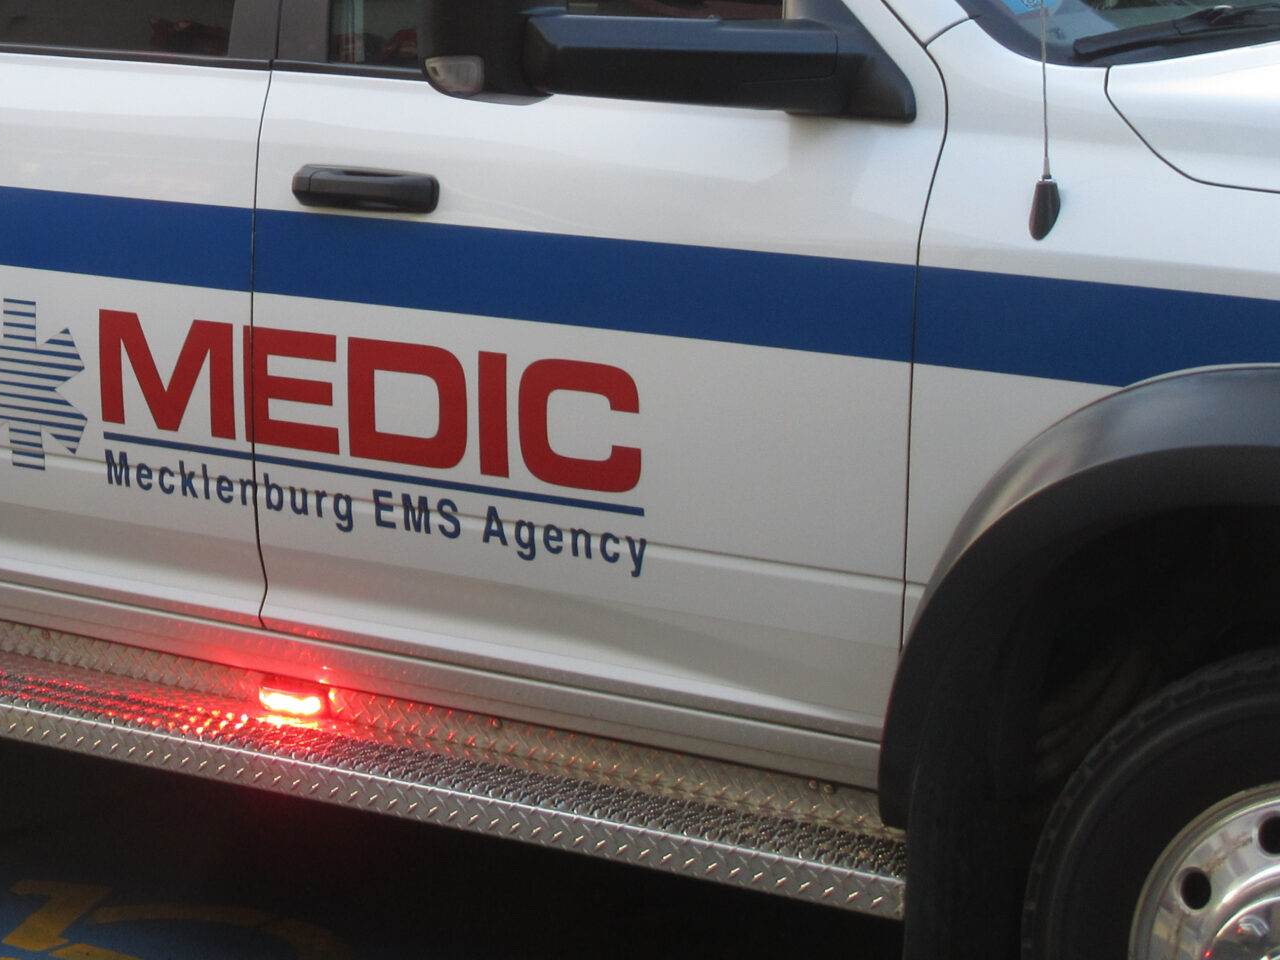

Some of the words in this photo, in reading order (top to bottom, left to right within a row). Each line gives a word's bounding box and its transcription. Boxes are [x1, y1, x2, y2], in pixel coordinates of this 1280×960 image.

[98, 308, 643, 493] MEDIC
[104, 448, 354, 533] Mecklenburg
[372, 488, 461, 540] EMS
[482, 505, 648, 578] Agency
